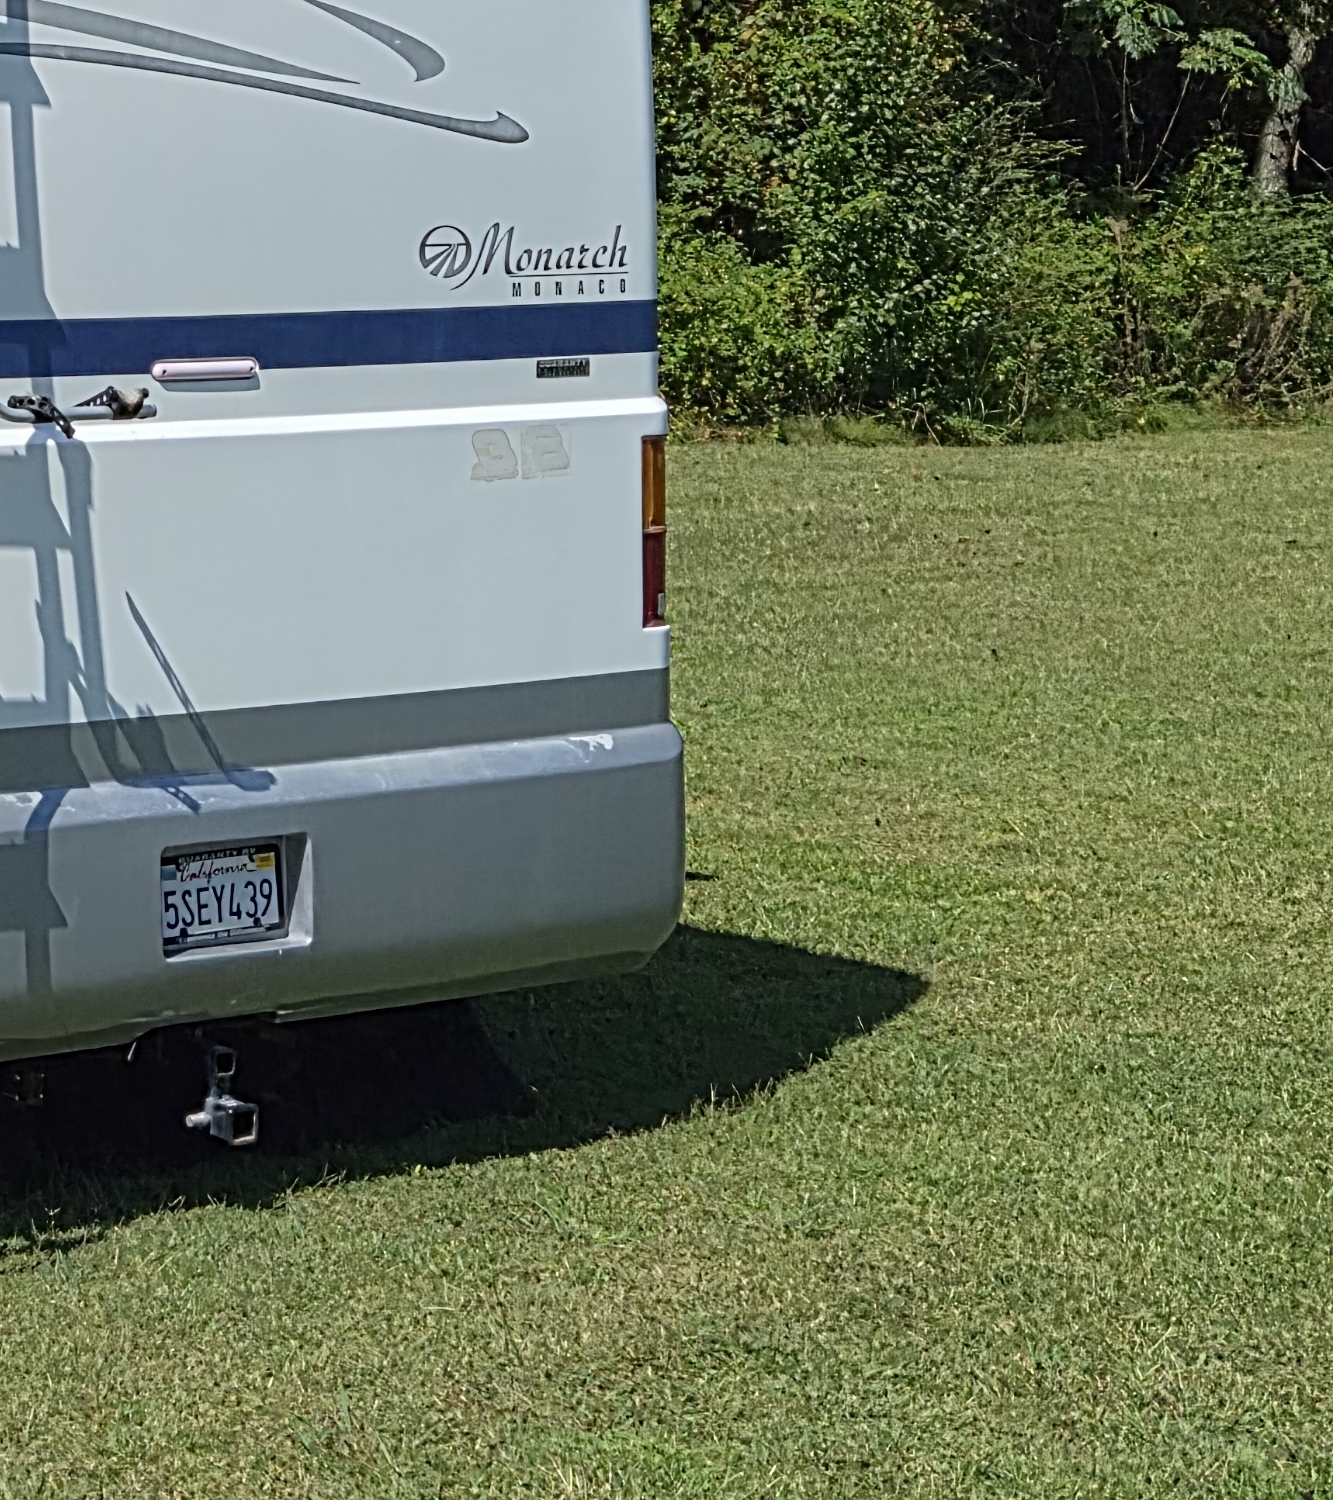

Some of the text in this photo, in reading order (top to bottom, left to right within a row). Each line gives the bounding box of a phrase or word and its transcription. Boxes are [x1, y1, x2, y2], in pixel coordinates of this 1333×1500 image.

[450, 222, 629, 291] Monarch
[511, 278, 627, 297] MONACO
[180, 860, 257, 885] California
[163, 878, 273, 930] 5SEY439
